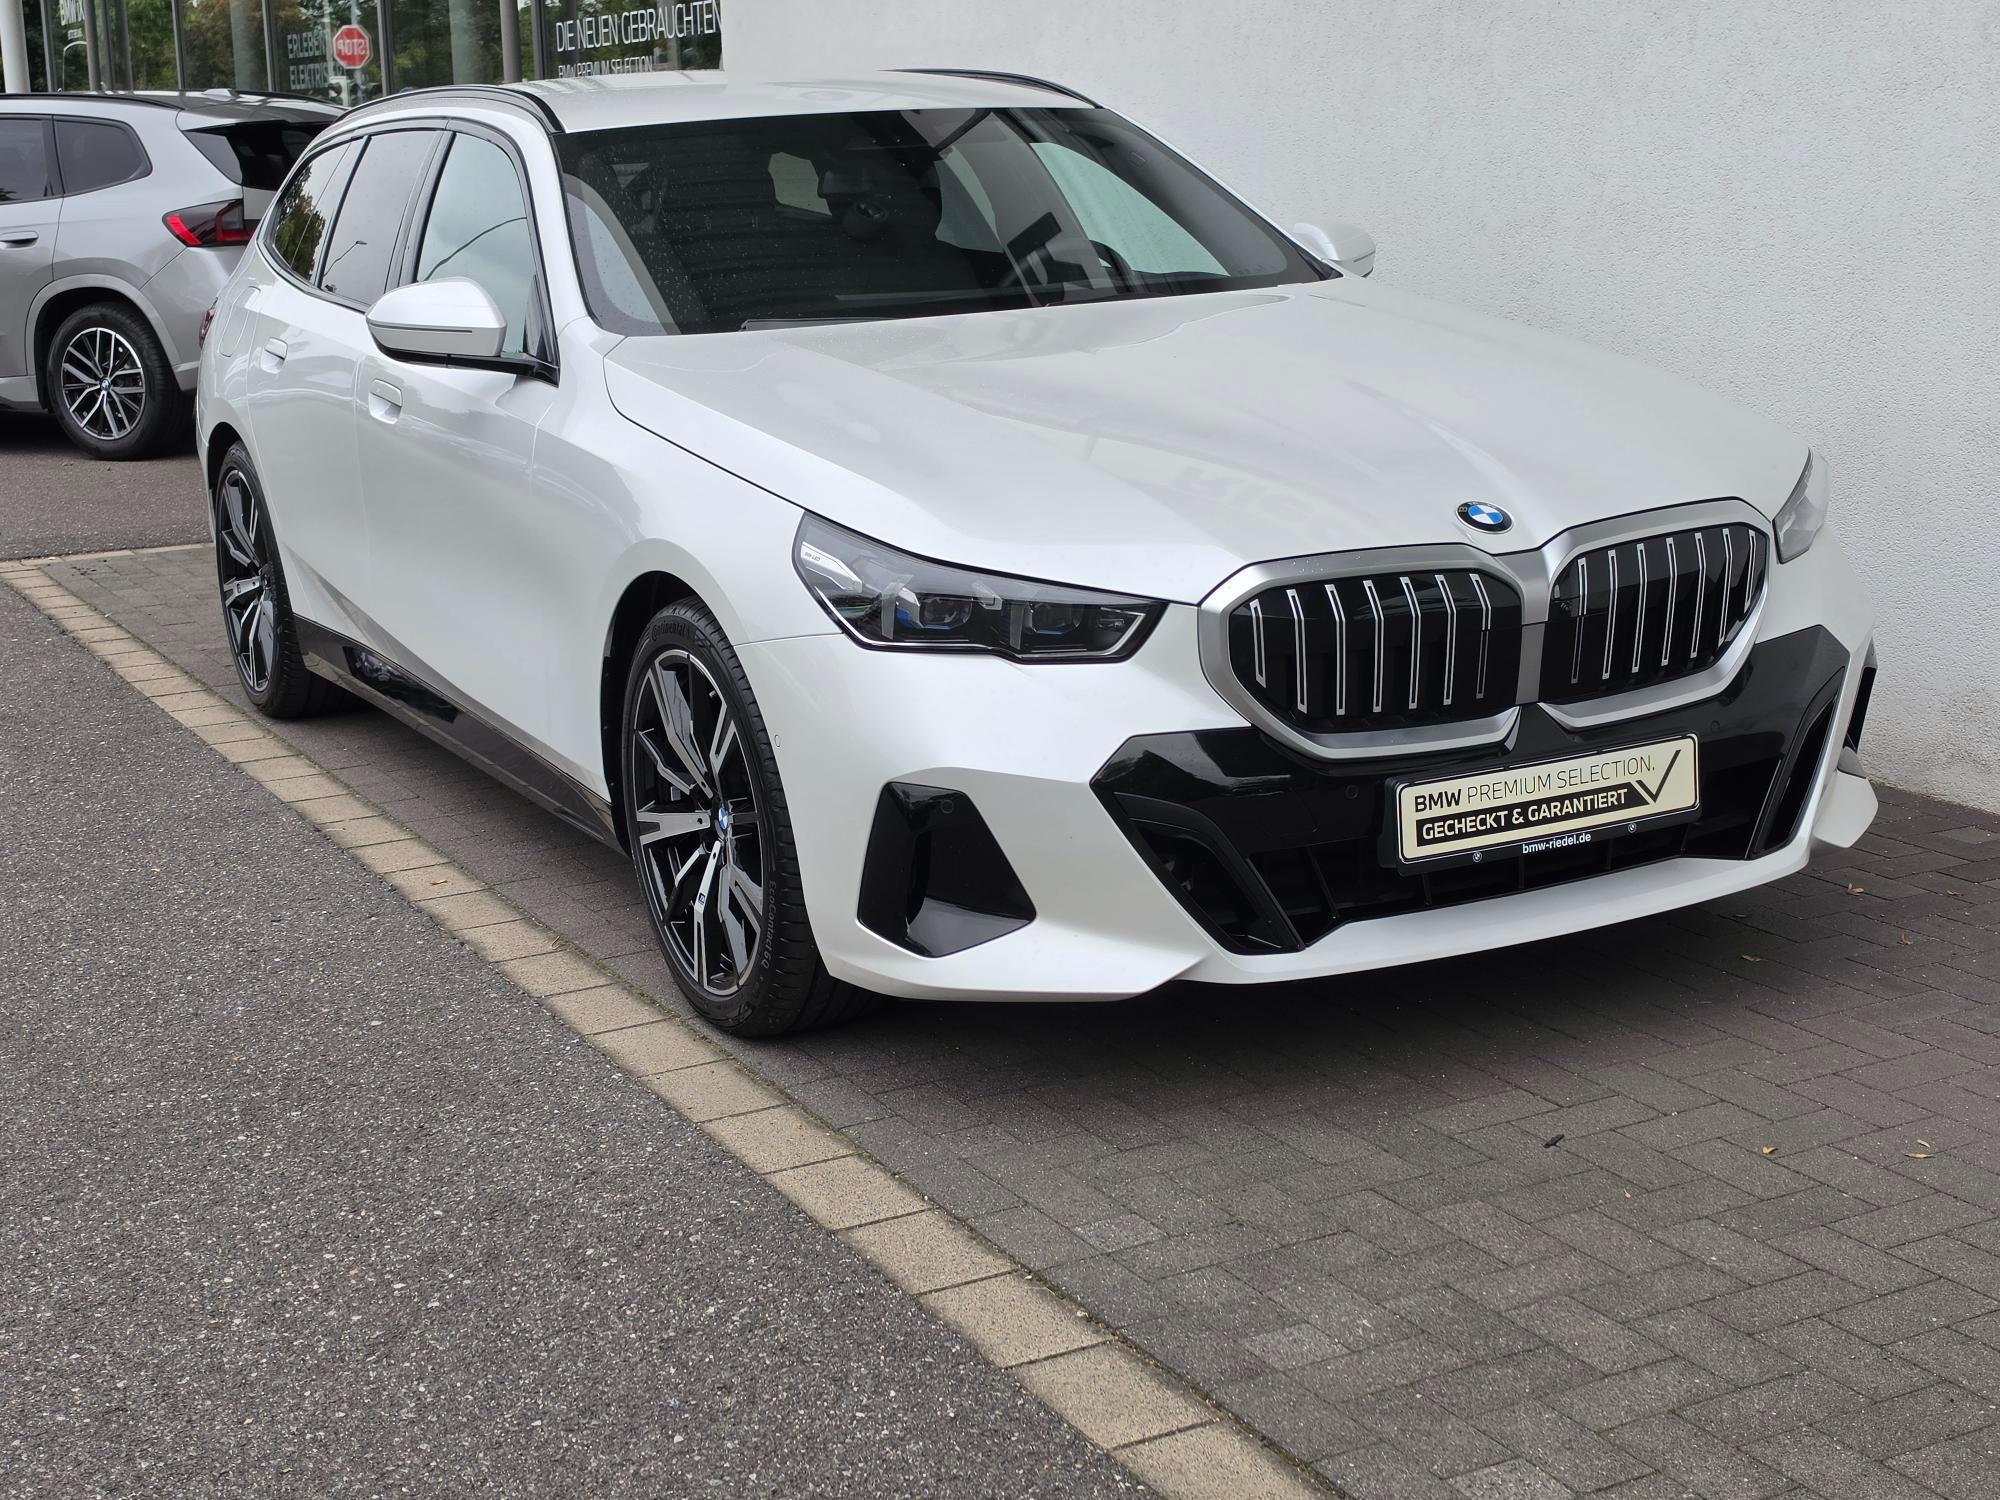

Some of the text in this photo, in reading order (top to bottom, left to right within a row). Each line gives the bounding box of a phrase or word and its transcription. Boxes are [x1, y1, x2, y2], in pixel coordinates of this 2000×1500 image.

[555, 0, 723, 52] DIE NEUEN GEBRAUCHTEN
[1415, 788, 1462, 813] BMW
[1467, 773, 1551, 804] PREMIUM
[1422, 788, 1628, 840] GECHECKT & GARANTIERT
[1522, 832, 1592, 854] bmw-riedel.de
